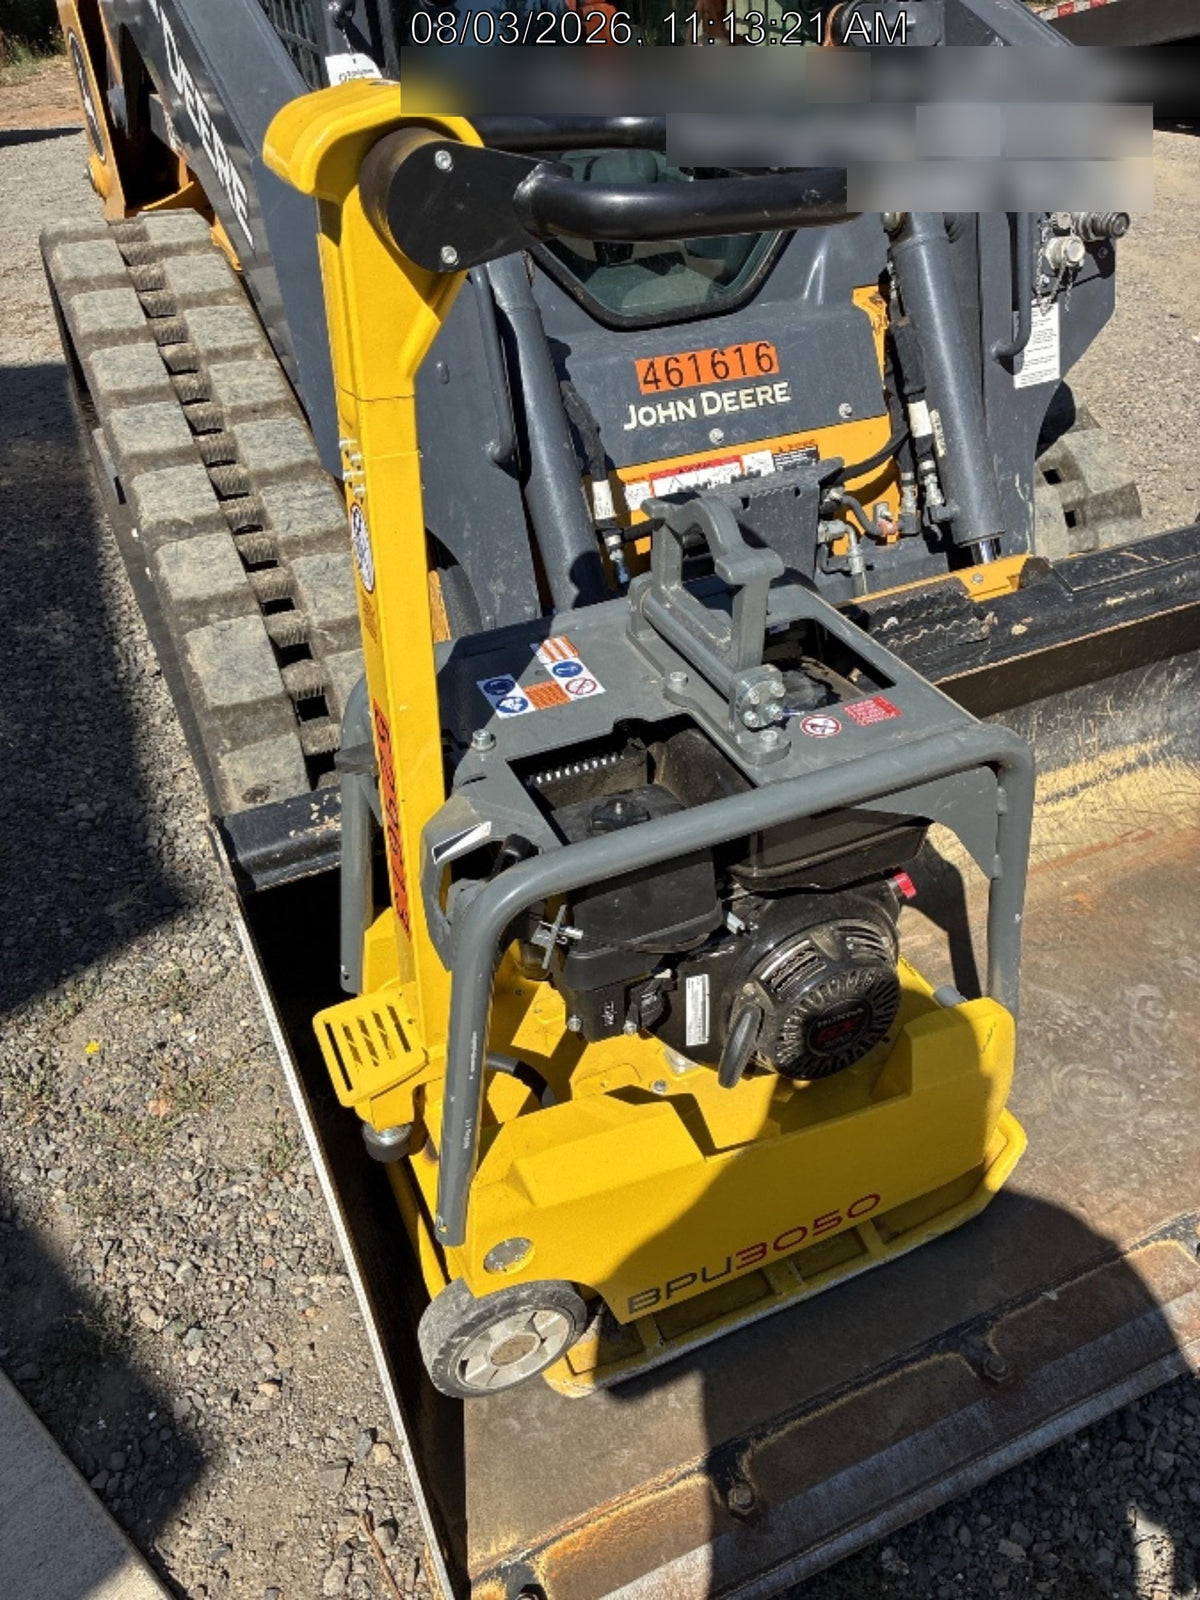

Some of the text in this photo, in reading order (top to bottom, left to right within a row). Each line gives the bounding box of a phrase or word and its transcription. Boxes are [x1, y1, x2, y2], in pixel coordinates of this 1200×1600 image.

[642, 342, 774, 390] 461616
[623, 382, 792, 430] JOHN DEERE
[627, 1192, 882, 1315] BPU3050
